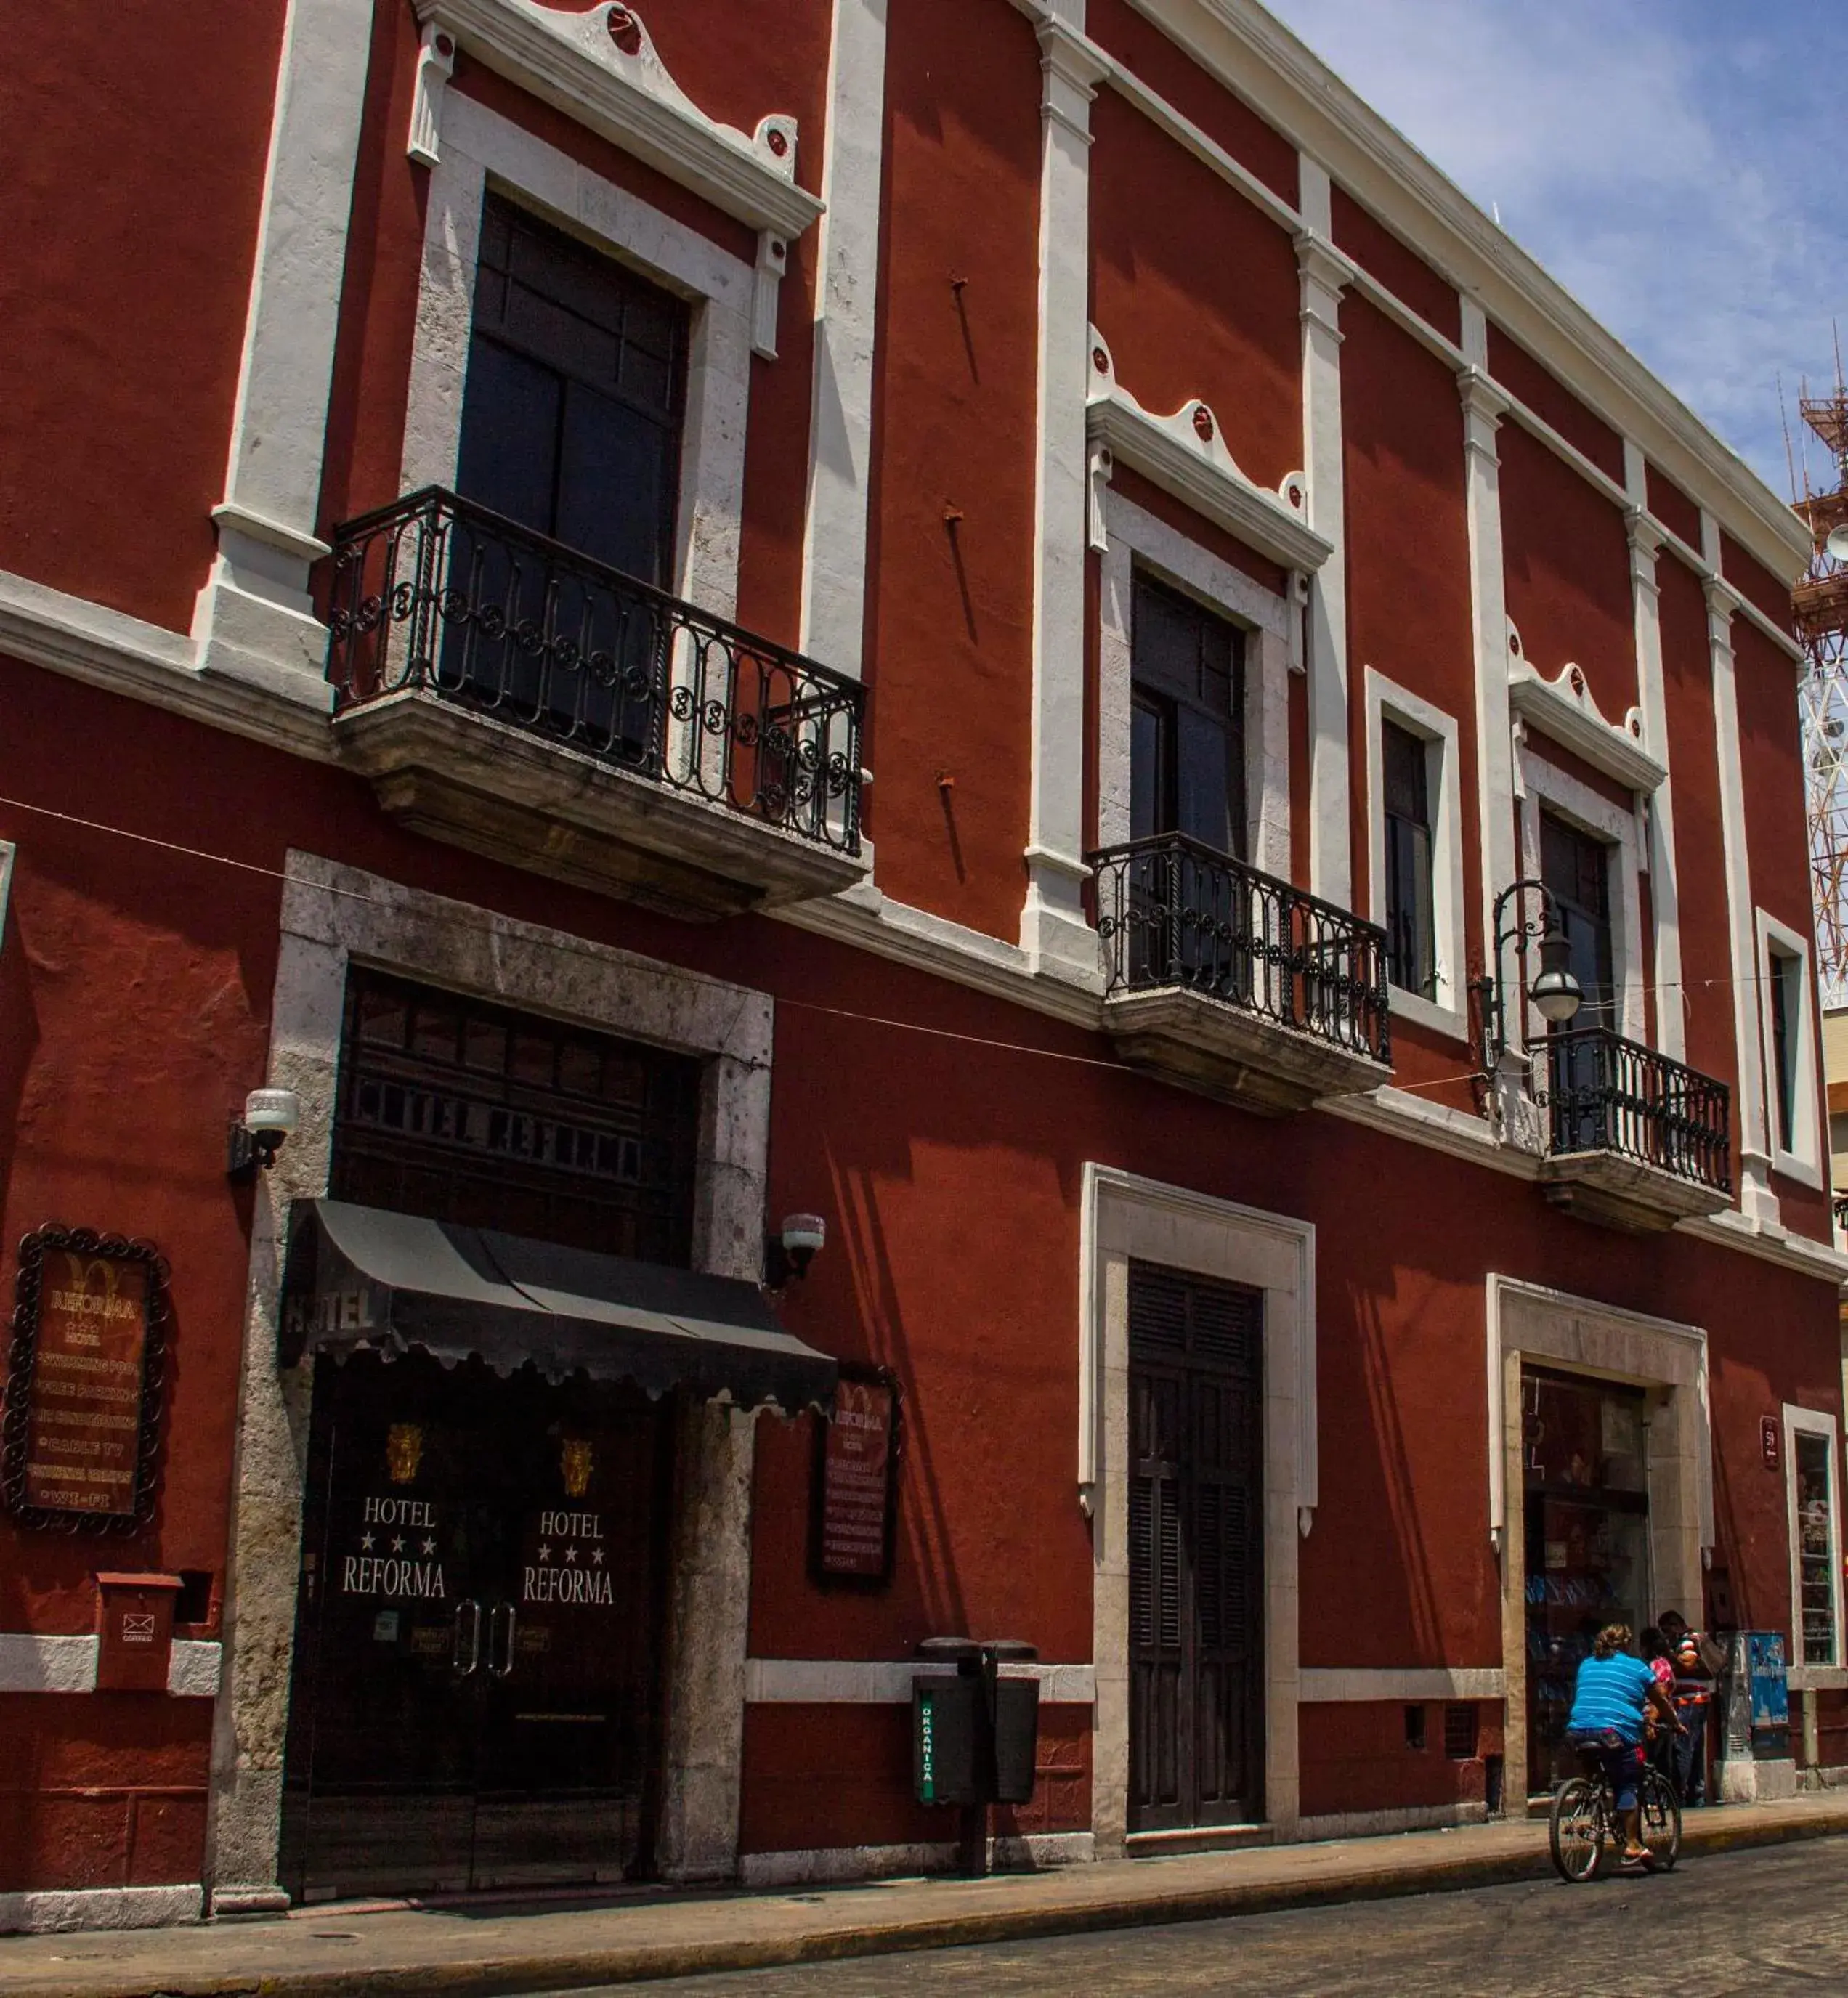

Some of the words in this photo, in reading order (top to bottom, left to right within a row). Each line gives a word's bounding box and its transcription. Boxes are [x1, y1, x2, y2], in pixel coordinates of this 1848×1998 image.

[51, 1290, 136, 1320] REFORMA
[102, 1442, 125, 1458] TV
[365, 1497, 436, 1528] HOTEL
[540, 1511, 603, 1539] HOTEL
[343, 1556, 446, 1599] REFORMA
[524, 1567, 615, 1605] REFORMA
[921, 1707, 933, 1782] ORGANICA
